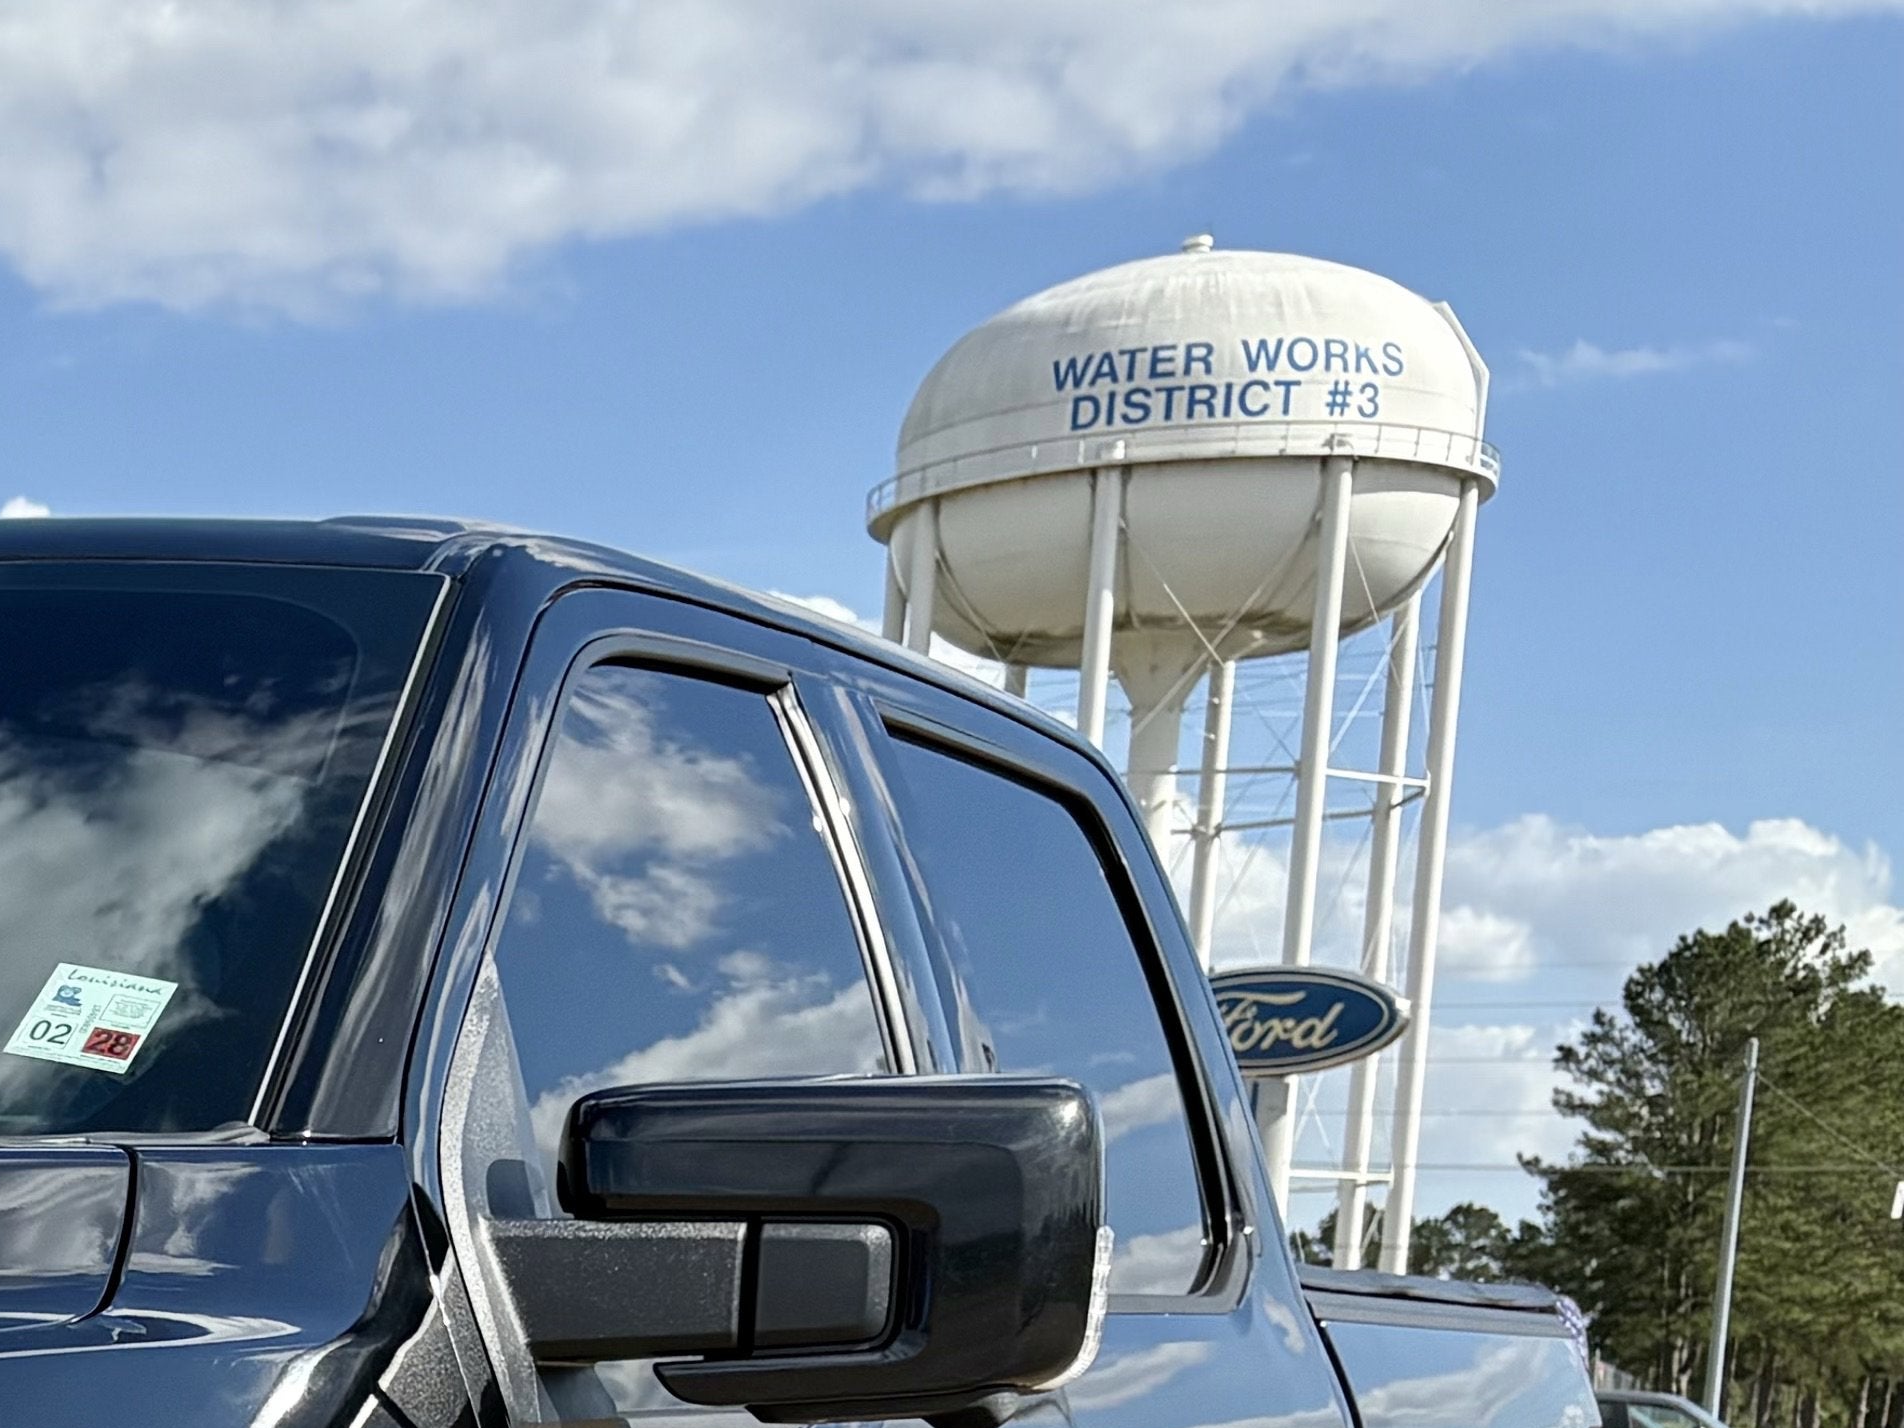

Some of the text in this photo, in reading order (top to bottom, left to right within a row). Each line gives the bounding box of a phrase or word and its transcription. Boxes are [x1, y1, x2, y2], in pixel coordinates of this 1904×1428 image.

[1053, 336, 1405, 393] WATER WORKS
[1070, 379, 1381, 431] DISTRICT #3
[67, 968, 163, 996] Louisiana
[29, 1019, 73, 1046] 02
[1214, 989, 1345, 1053] Ford
